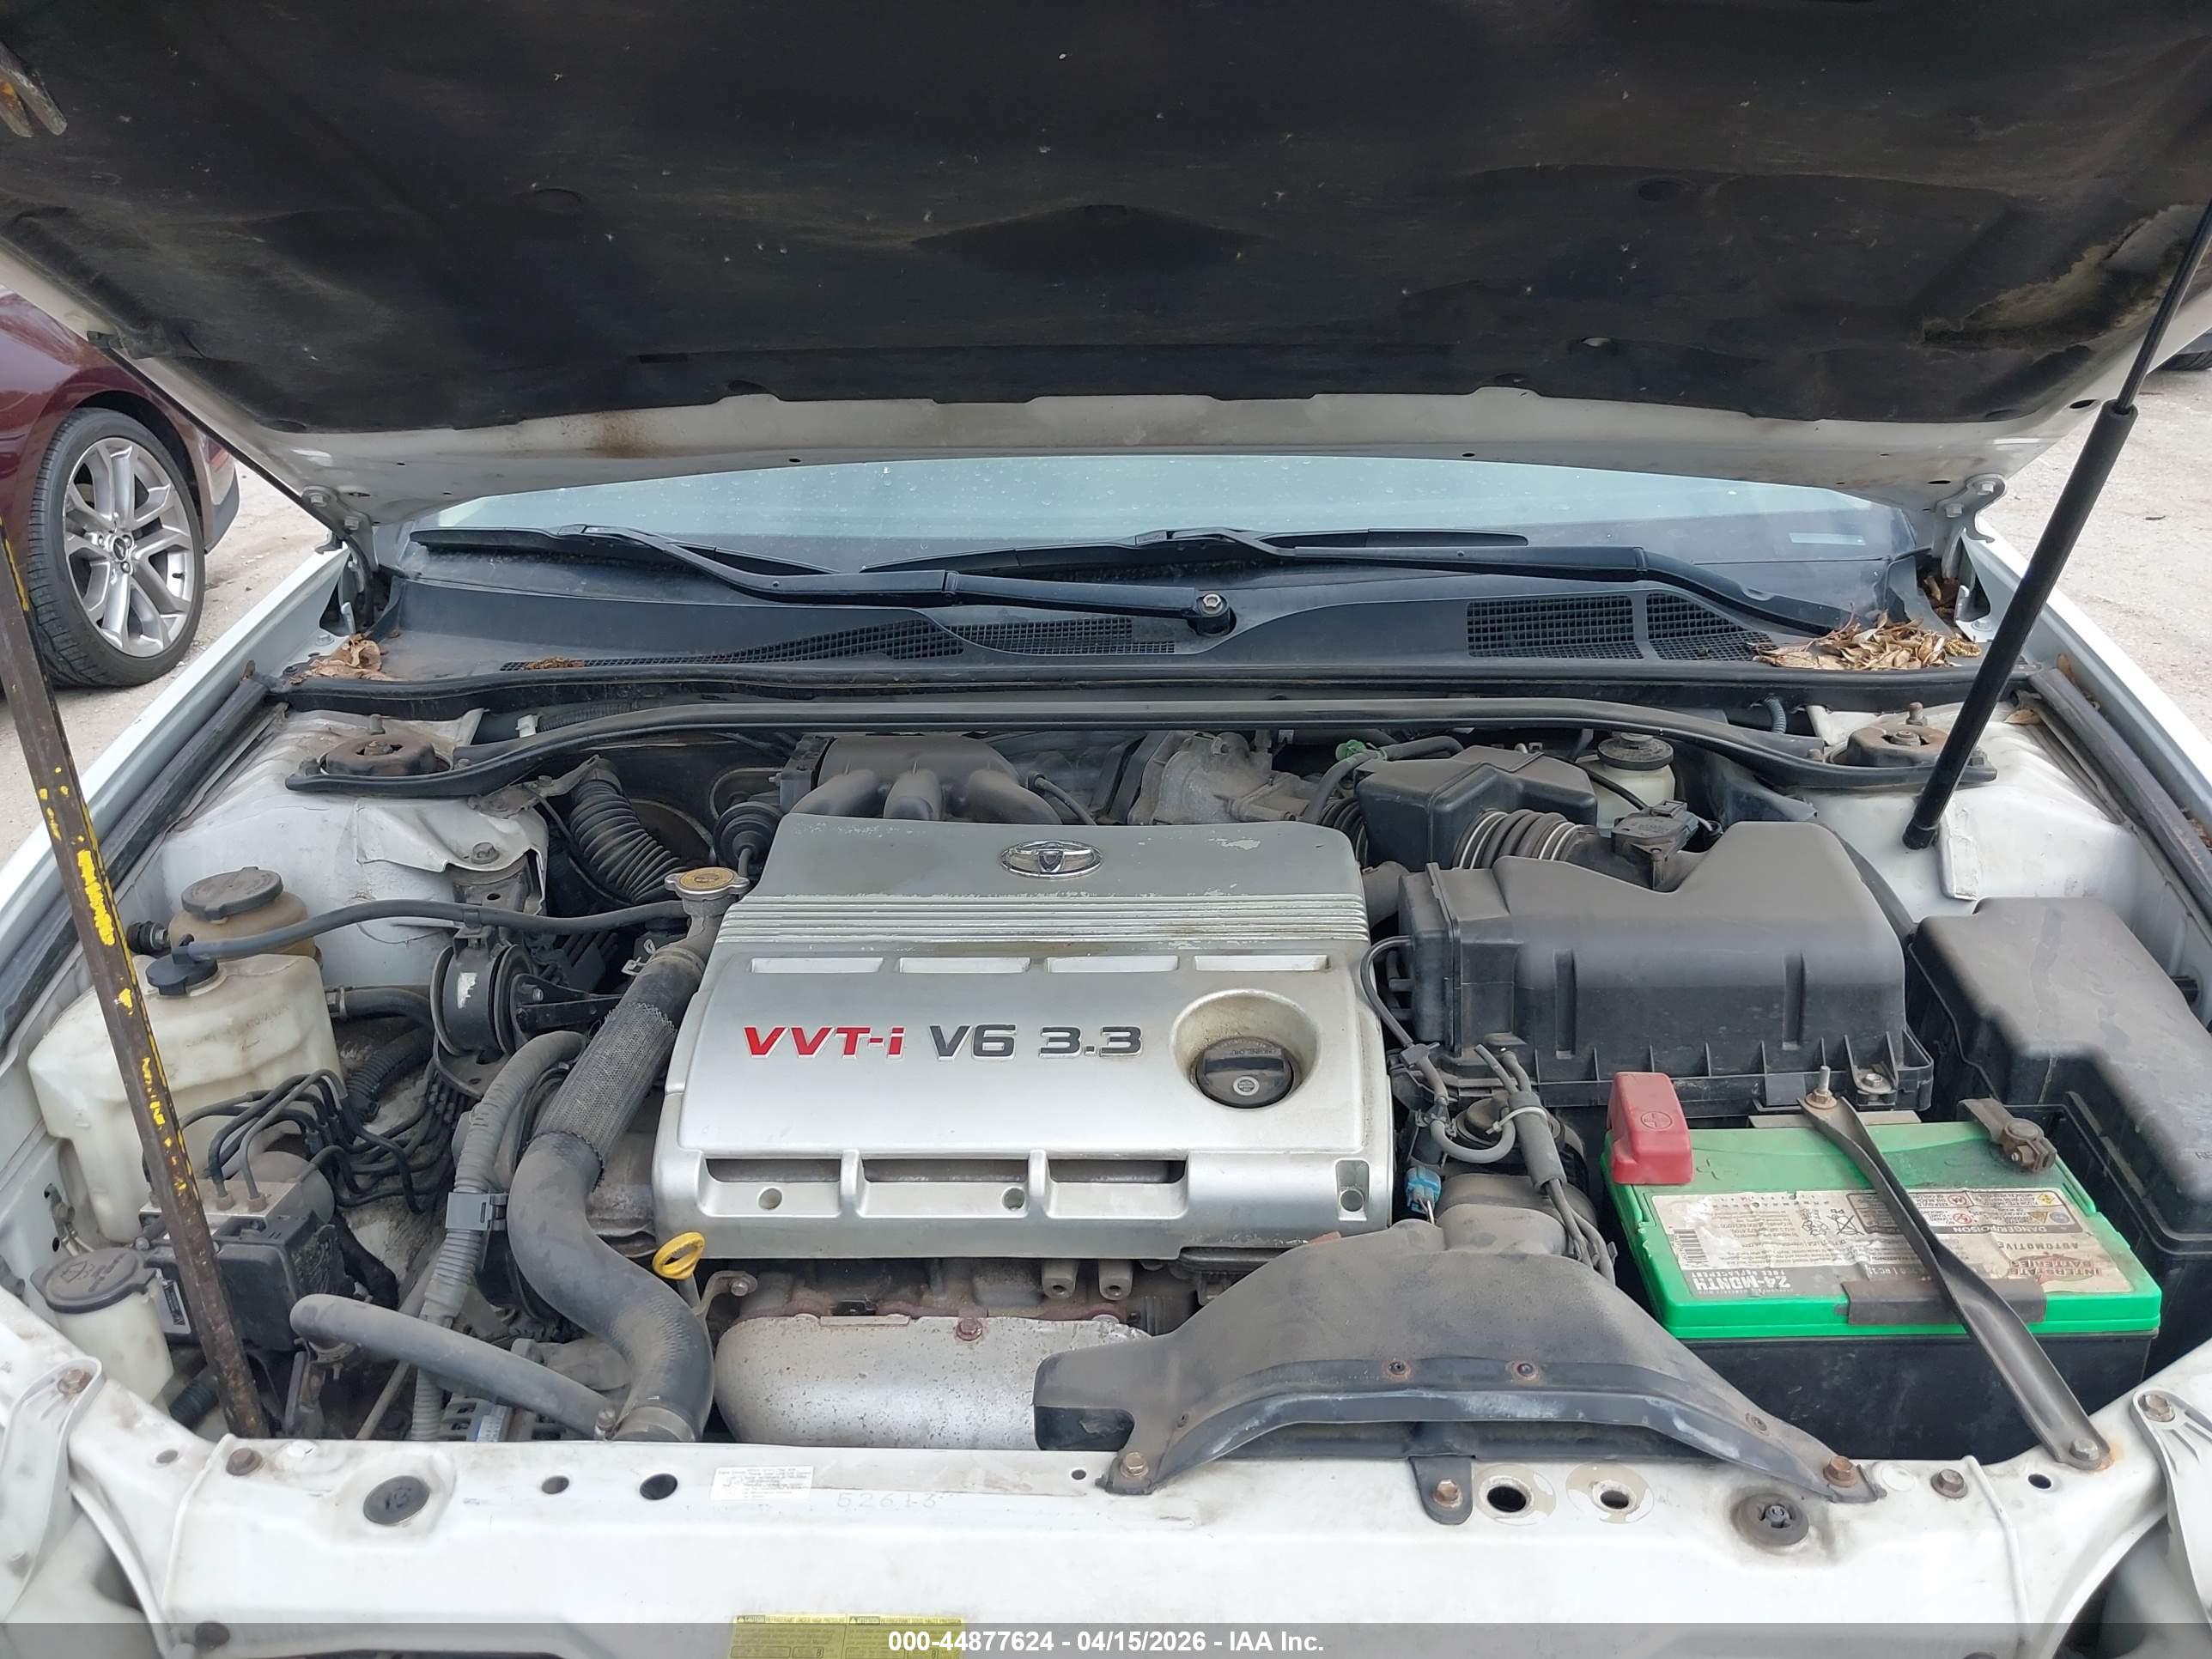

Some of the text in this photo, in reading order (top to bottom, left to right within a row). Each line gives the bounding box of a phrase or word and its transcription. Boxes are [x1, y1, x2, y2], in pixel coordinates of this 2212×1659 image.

[743, 1024, 1143, 1061] VVT-i V6 3.3
[1998, 1241, 2078, 1251] AUTOMOTIVE
[2009, 1260, 2092, 1268] BATTERIES
[2007, 1267, 2102, 1277] INTERSTATE
[1692, 1276, 1790, 1291] 24-MONTH
